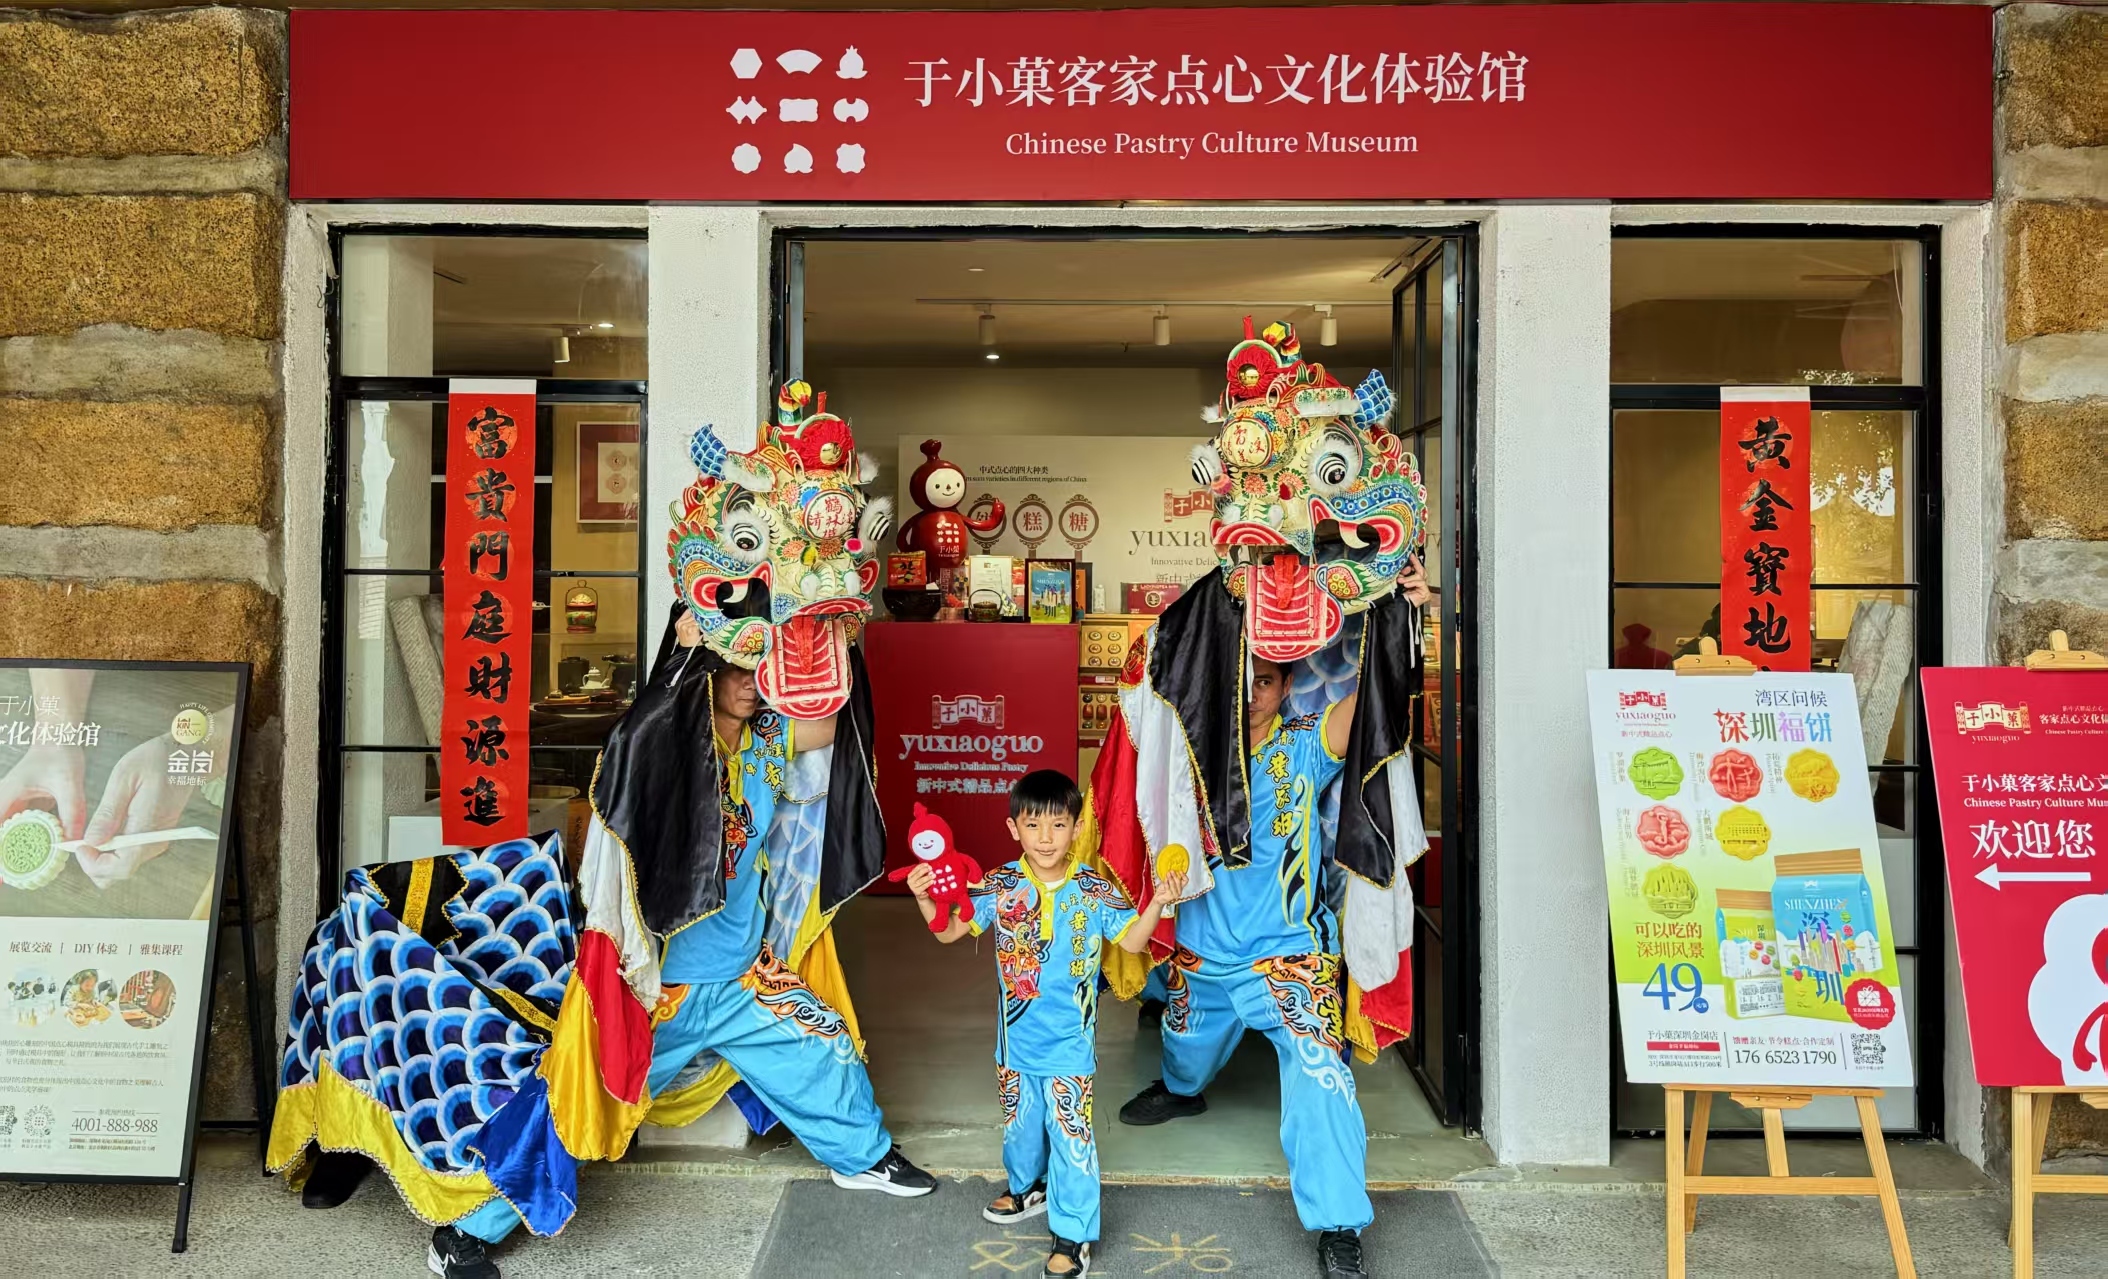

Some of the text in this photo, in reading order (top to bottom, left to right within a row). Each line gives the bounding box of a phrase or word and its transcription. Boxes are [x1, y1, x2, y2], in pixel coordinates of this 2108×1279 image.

[904, 51, 1530, 107] 于小菓客家点心文化体验馆
[1005, 130, 1420, 161] Chinese Pastry Culture Museum
[1023, 511, 1043, 532] 糕
[1068, 511, 1089, 532] 糖
[1151, 557, 1218, 566] Innovative Delic
[0, 695, 61, 717] 于小菓
[1755, 689, 1829, 707] 湾区问候
[941, 702, 993, 722] 于小菓
[1615, 711, 1677, 723] yuxiaoguo
[1966, 708, 2020, 728] 于小菓
[1713, 708, 1832, 744] 深圳福饼
[898, 734, 1044, 761] yuxiaoguo
[1971, 735, 2020, 744] yuxiaoguo
[914, 761, 1029, 773] Innovative Delicious Pastry
[1963, 797, 2007, 808] Chinese
[2008, 797, 2042, 810] Pastry
[2044, 797, 2085, 808] Culture
[1968, 818, 2097, 860] 欢迎您
[1633, 921, 1703, 939] 可以吃的
[9, 941, 53, 954] 展览交流
[74, 942, 118, 955] DIY 体验
[140, 943, 184, 956] 雅集课程
[1636, 941, 1705, 959] 深圳风景
[1642, 962, 1703, 1012] 49
[1648, 1030, 1719, 1041] 于小菓深圳金岗店
[1734, 1049, 1761, 1064] 176
[1765, 1050, 1800, 1065] 6523
[1803, 1050, 1837, 1065] 1790
[71, 1117, 159, 1132] 4001-888-988
